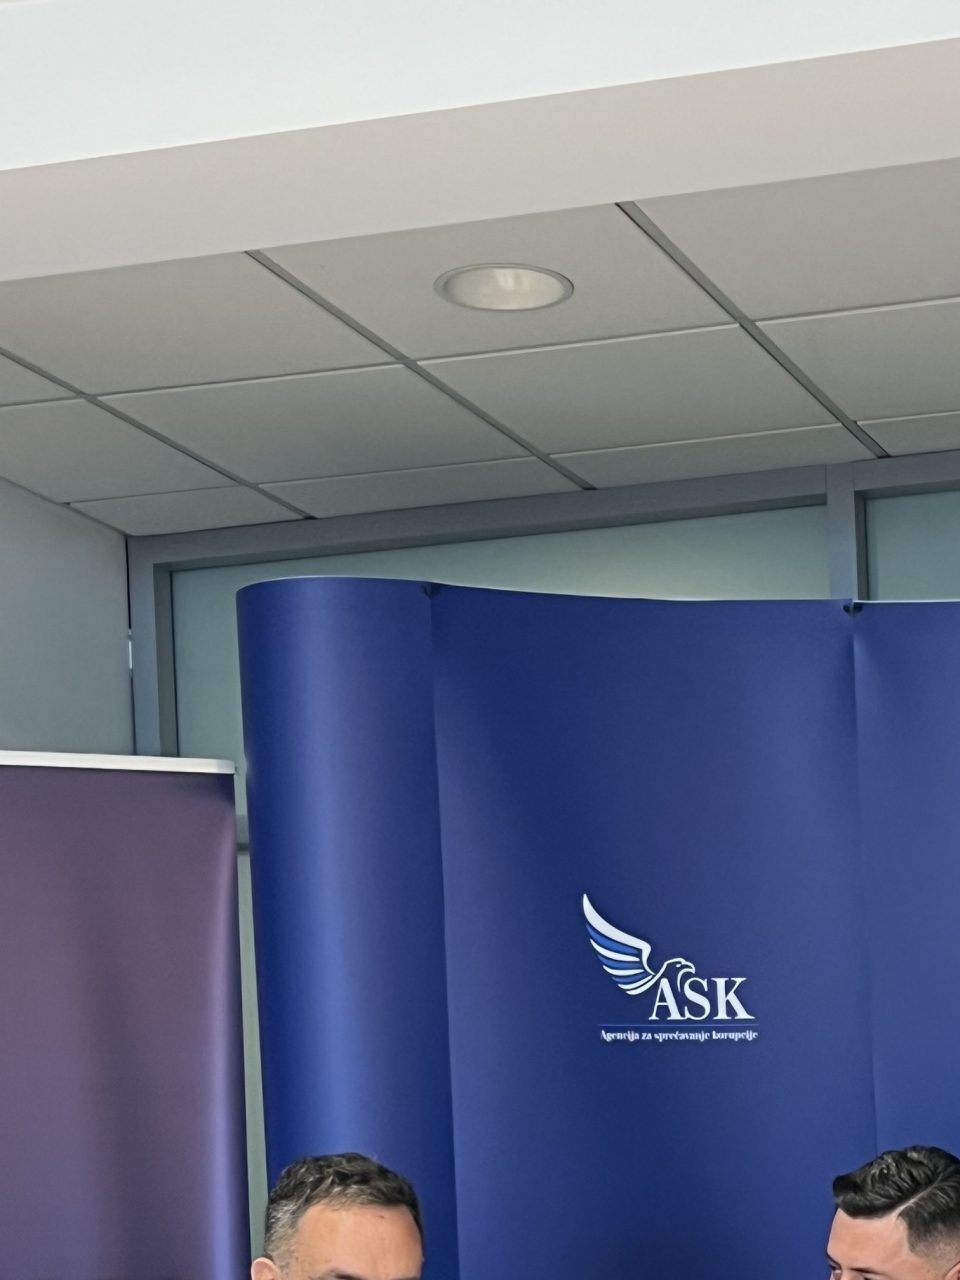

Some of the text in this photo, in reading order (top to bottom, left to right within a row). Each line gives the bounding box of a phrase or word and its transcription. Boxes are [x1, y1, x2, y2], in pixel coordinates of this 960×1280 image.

[601, 1030, 640, 1042] Agencija
[641, 1031, 653, 1040] za
[712, 1029, 758, 1042] korupcije
